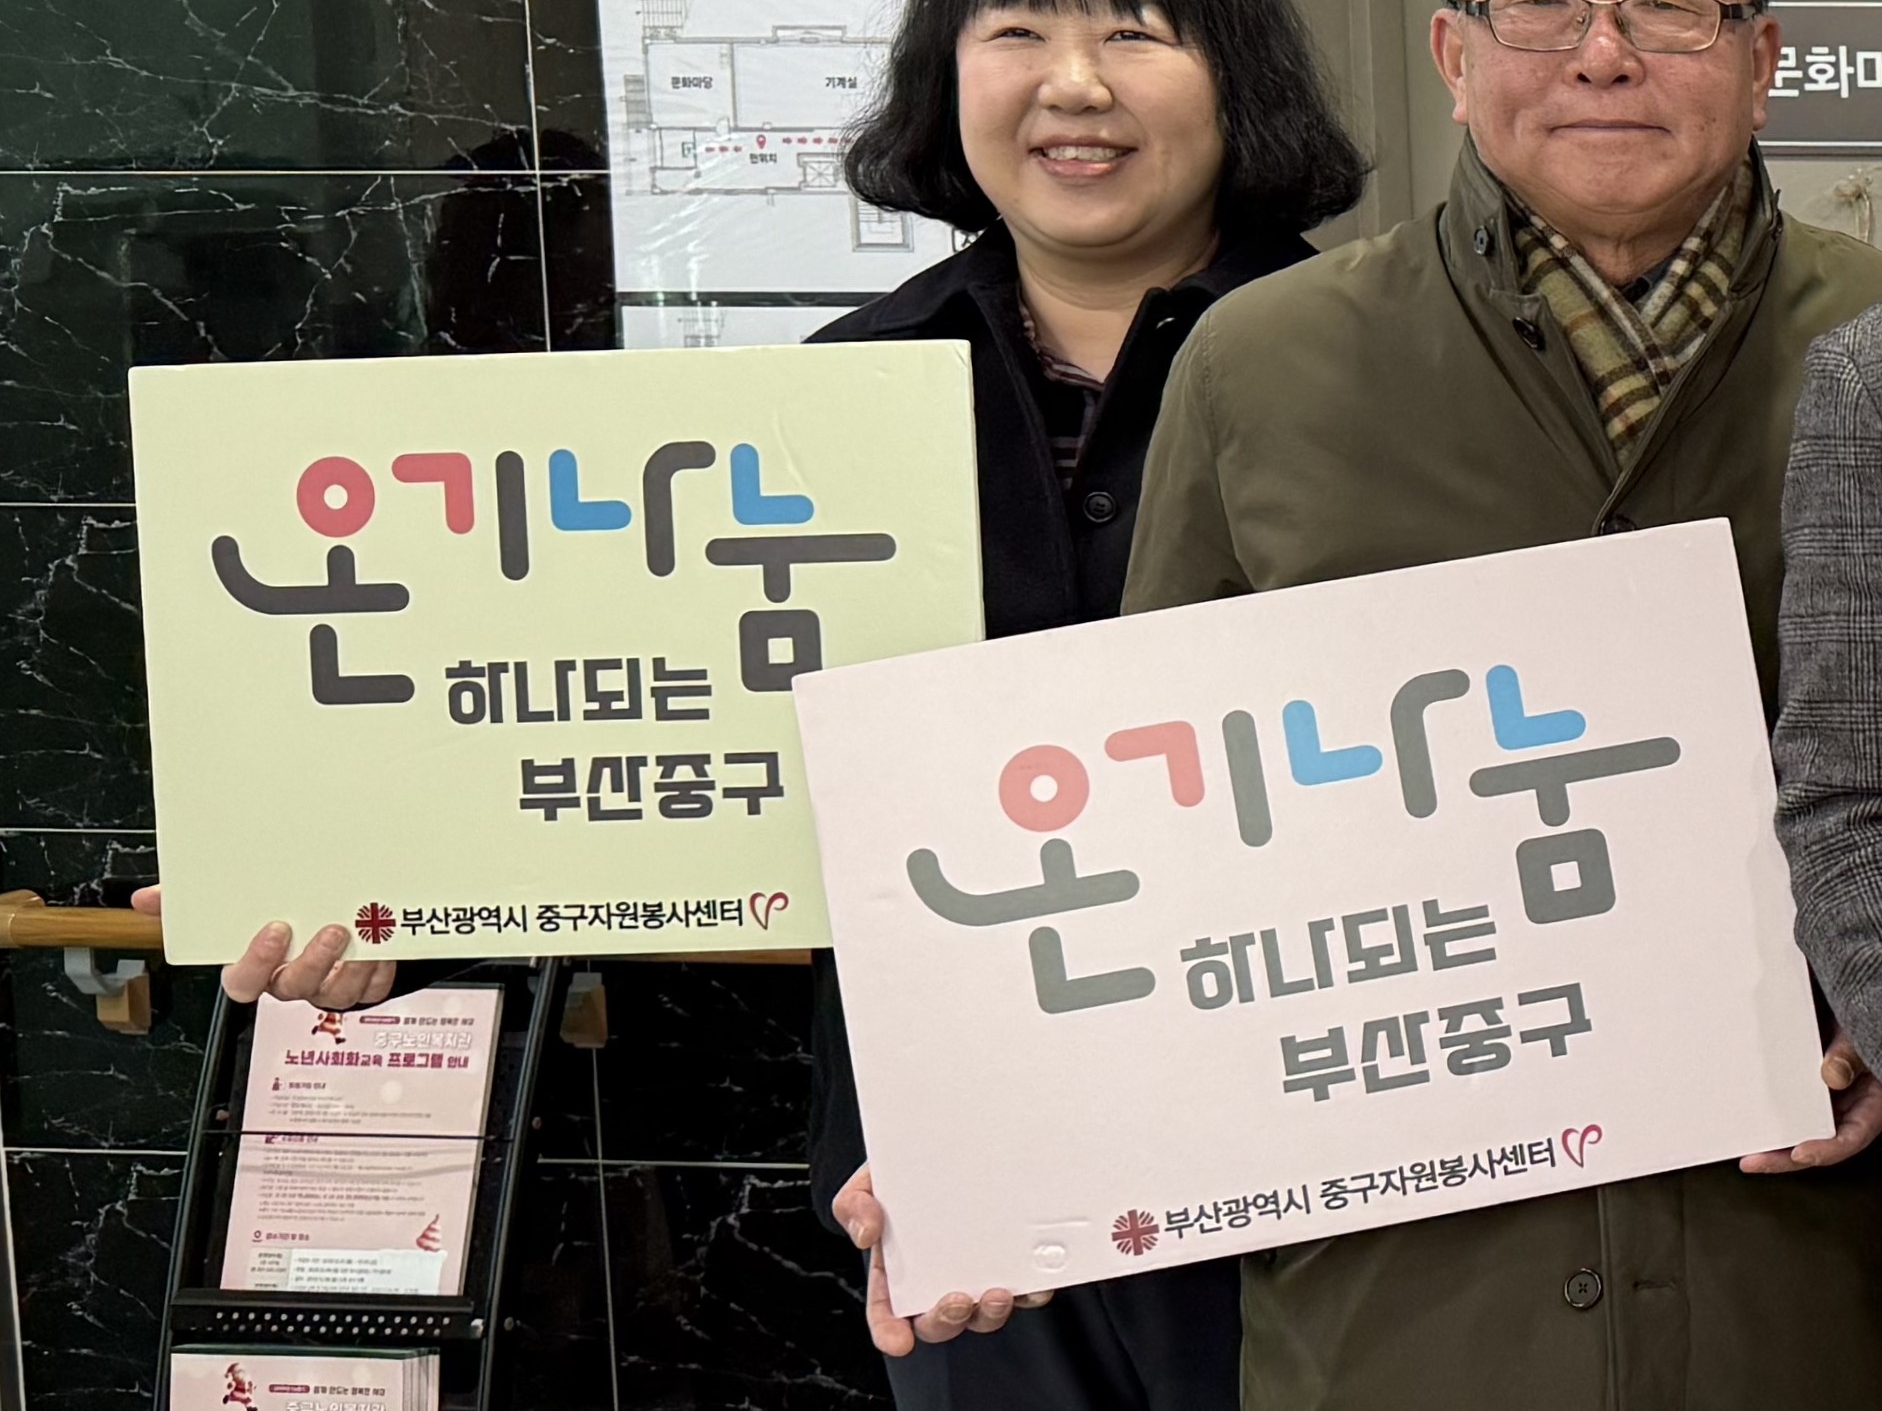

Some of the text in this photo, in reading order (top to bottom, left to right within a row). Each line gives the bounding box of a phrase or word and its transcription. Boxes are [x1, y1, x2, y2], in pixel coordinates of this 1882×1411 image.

[671, 76, 857, 88] 문화마당 기계실
[211, 440, 897, 706] 온기나눔
[445, 657, 713, 725] 하나되는
[518, 751, 785, 822] 부산중구
[906, 663, 1681, 1015] 온기나눔
[400, 898, 744, 937] 부산광역시 중구자원봉사센터
[1179, 899, 1499, 1010] 하나되는
[1280, 982, 1592, 1102] 부산중구
[1163, 1136, 1558, 1239] 부산광역시 중구자원봉사센터
